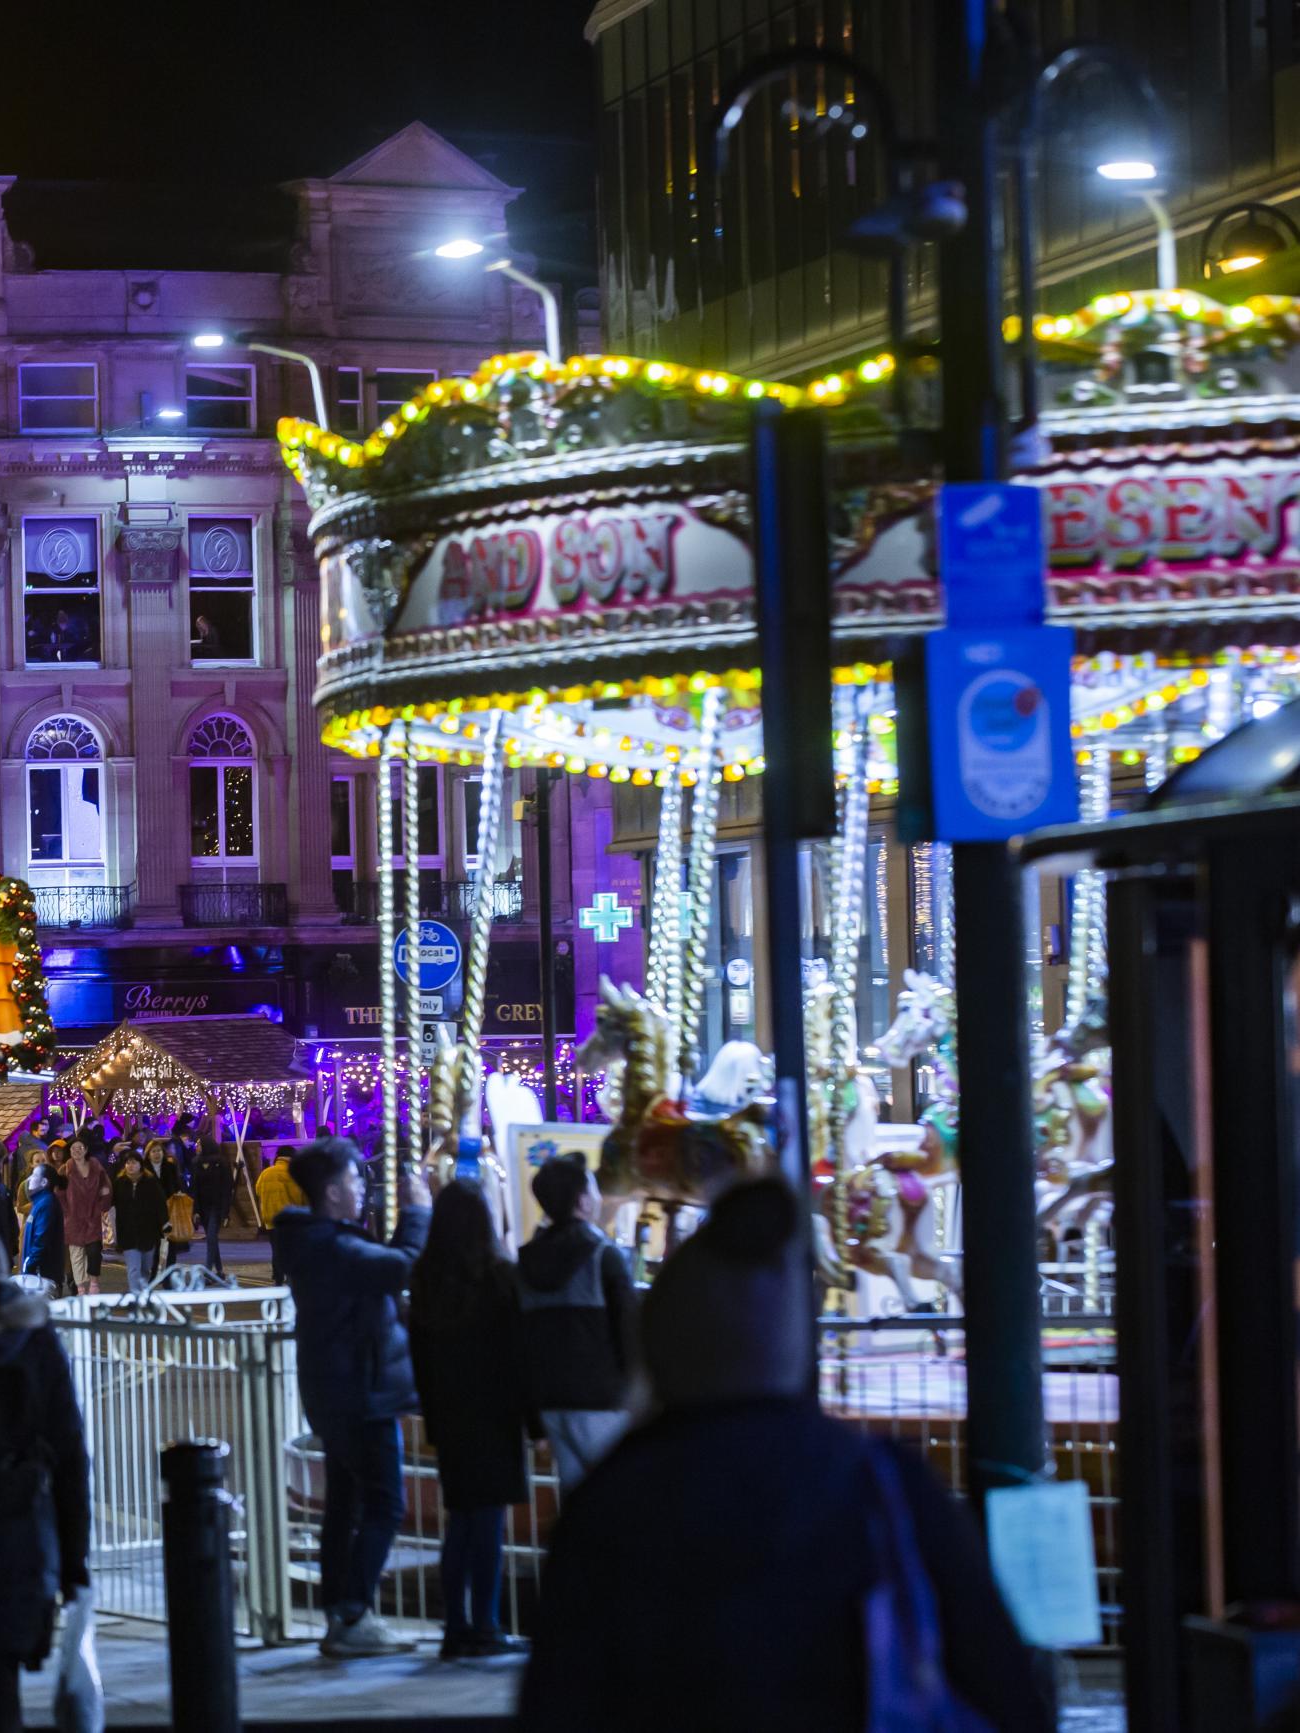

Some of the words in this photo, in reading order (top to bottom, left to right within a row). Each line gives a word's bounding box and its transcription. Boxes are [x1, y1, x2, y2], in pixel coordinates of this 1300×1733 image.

[1045, 473, 1300, 566] ESEN
[440, 527, 542, 614] AND
[551, 515, 684, 606] SON
[419, 948, 444, 957] ocal
[124, 984, 209, 1016] Berrys
[345, 1006, 383, 1024] THE
[158, 1064, 173, 1079] Ski
